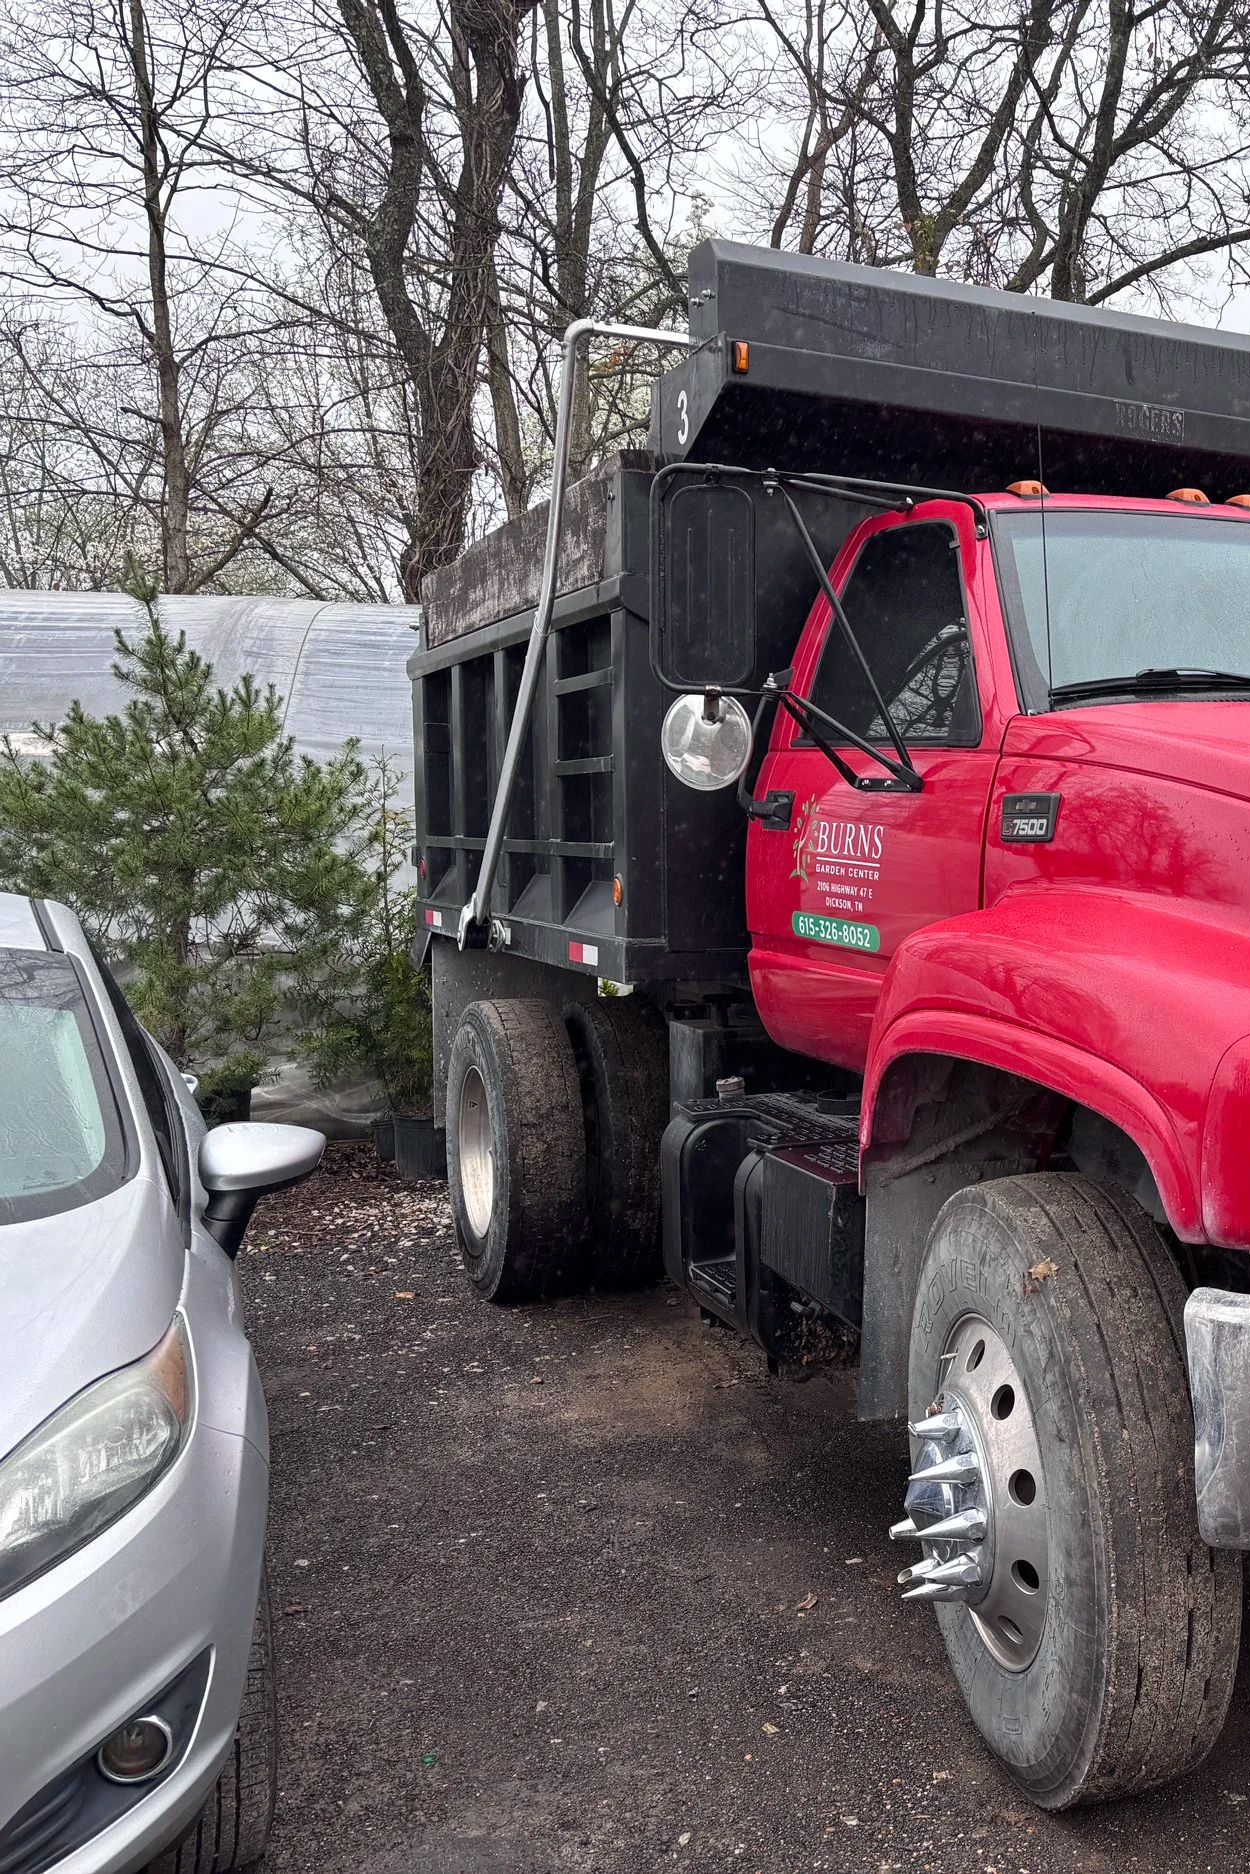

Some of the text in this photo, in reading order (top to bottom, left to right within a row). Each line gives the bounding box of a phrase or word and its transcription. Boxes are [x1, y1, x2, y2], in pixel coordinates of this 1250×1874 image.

[677, 389, 689, 446] 3
[816, 821, 885, 860] BURNS
[815, 863, 880, 881] GARDEN CENTER
[816, 881, 873, 899] 2106 HIGHWAY 47 E
[825, 896, 863, 913] DICKSON, TN
[798, 916, 871, 948] 615-326-8052
